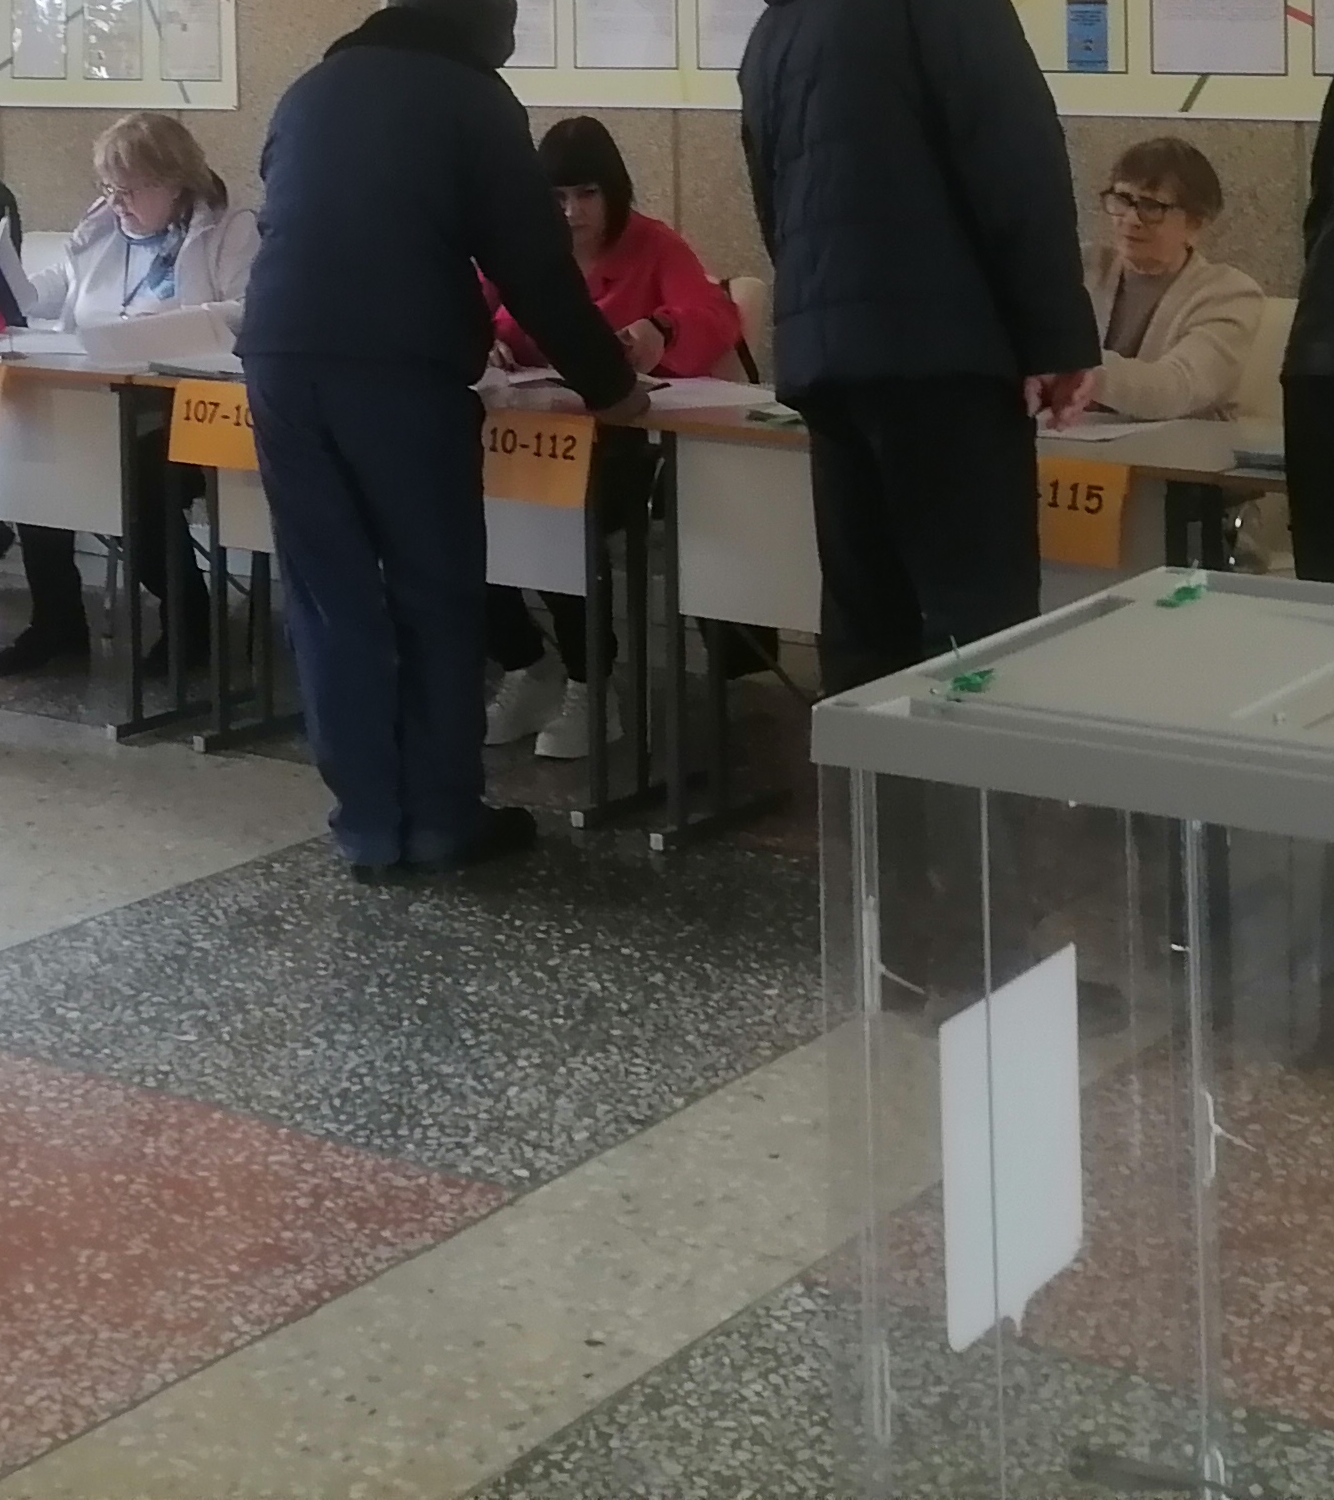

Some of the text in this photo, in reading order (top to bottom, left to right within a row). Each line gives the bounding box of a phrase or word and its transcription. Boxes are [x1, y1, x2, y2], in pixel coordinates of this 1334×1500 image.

[182, 398, 254, 428] 107-10
[488, 427, 578, 461] 10-112
[1036, 479, 1105, 515] -115
